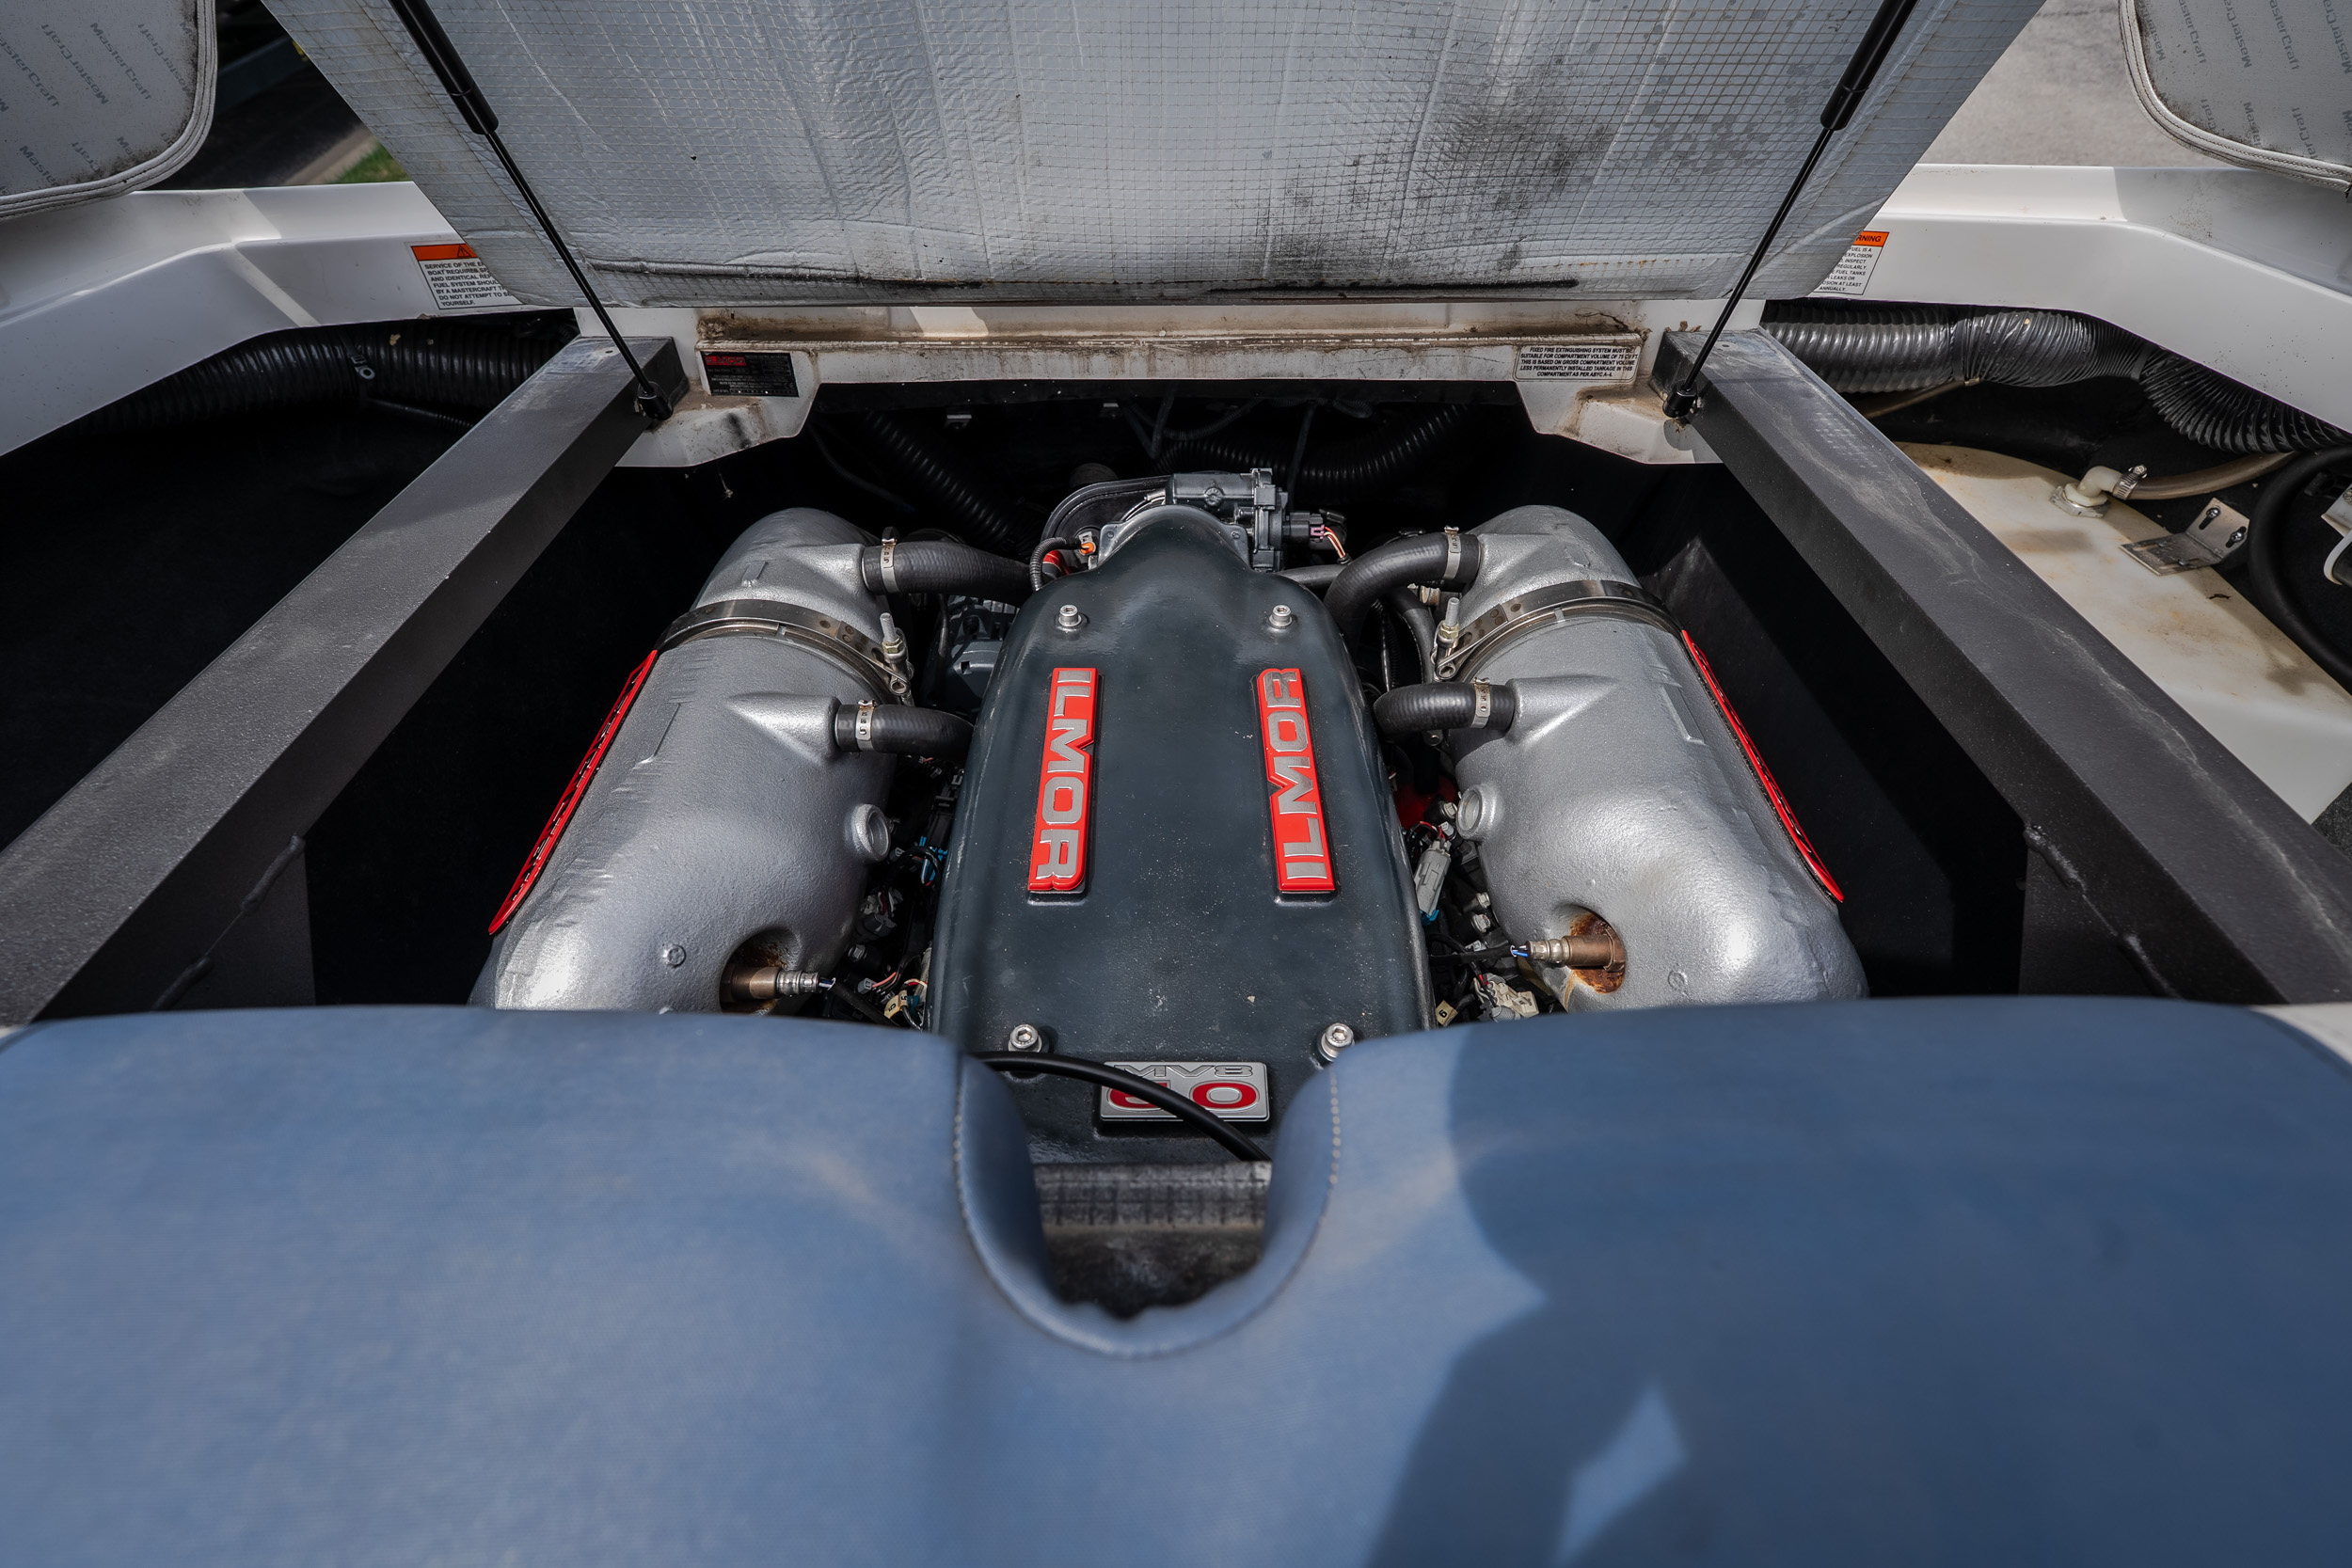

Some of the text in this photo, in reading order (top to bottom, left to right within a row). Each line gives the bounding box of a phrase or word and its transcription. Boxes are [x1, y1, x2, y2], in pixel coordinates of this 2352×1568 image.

[41, 24, 109, 104] MasterCraft
[90, 22, 152, 100] MasterCraft
[2178, 0, 2206, 64] asterCraft
[2224, 0, 2252, 68] MasterCra
[2269, 0, 2300, 70] asterCraft
[2322, 0, 2352, 73] MasterCra
[0, 33, 59, 107] asterCraft
[1036, 670, 1091, 879] ILMOR
[1263, 671, 1327, 879] ILMOR
[1114, 1065, 1253, 1077] MV8
